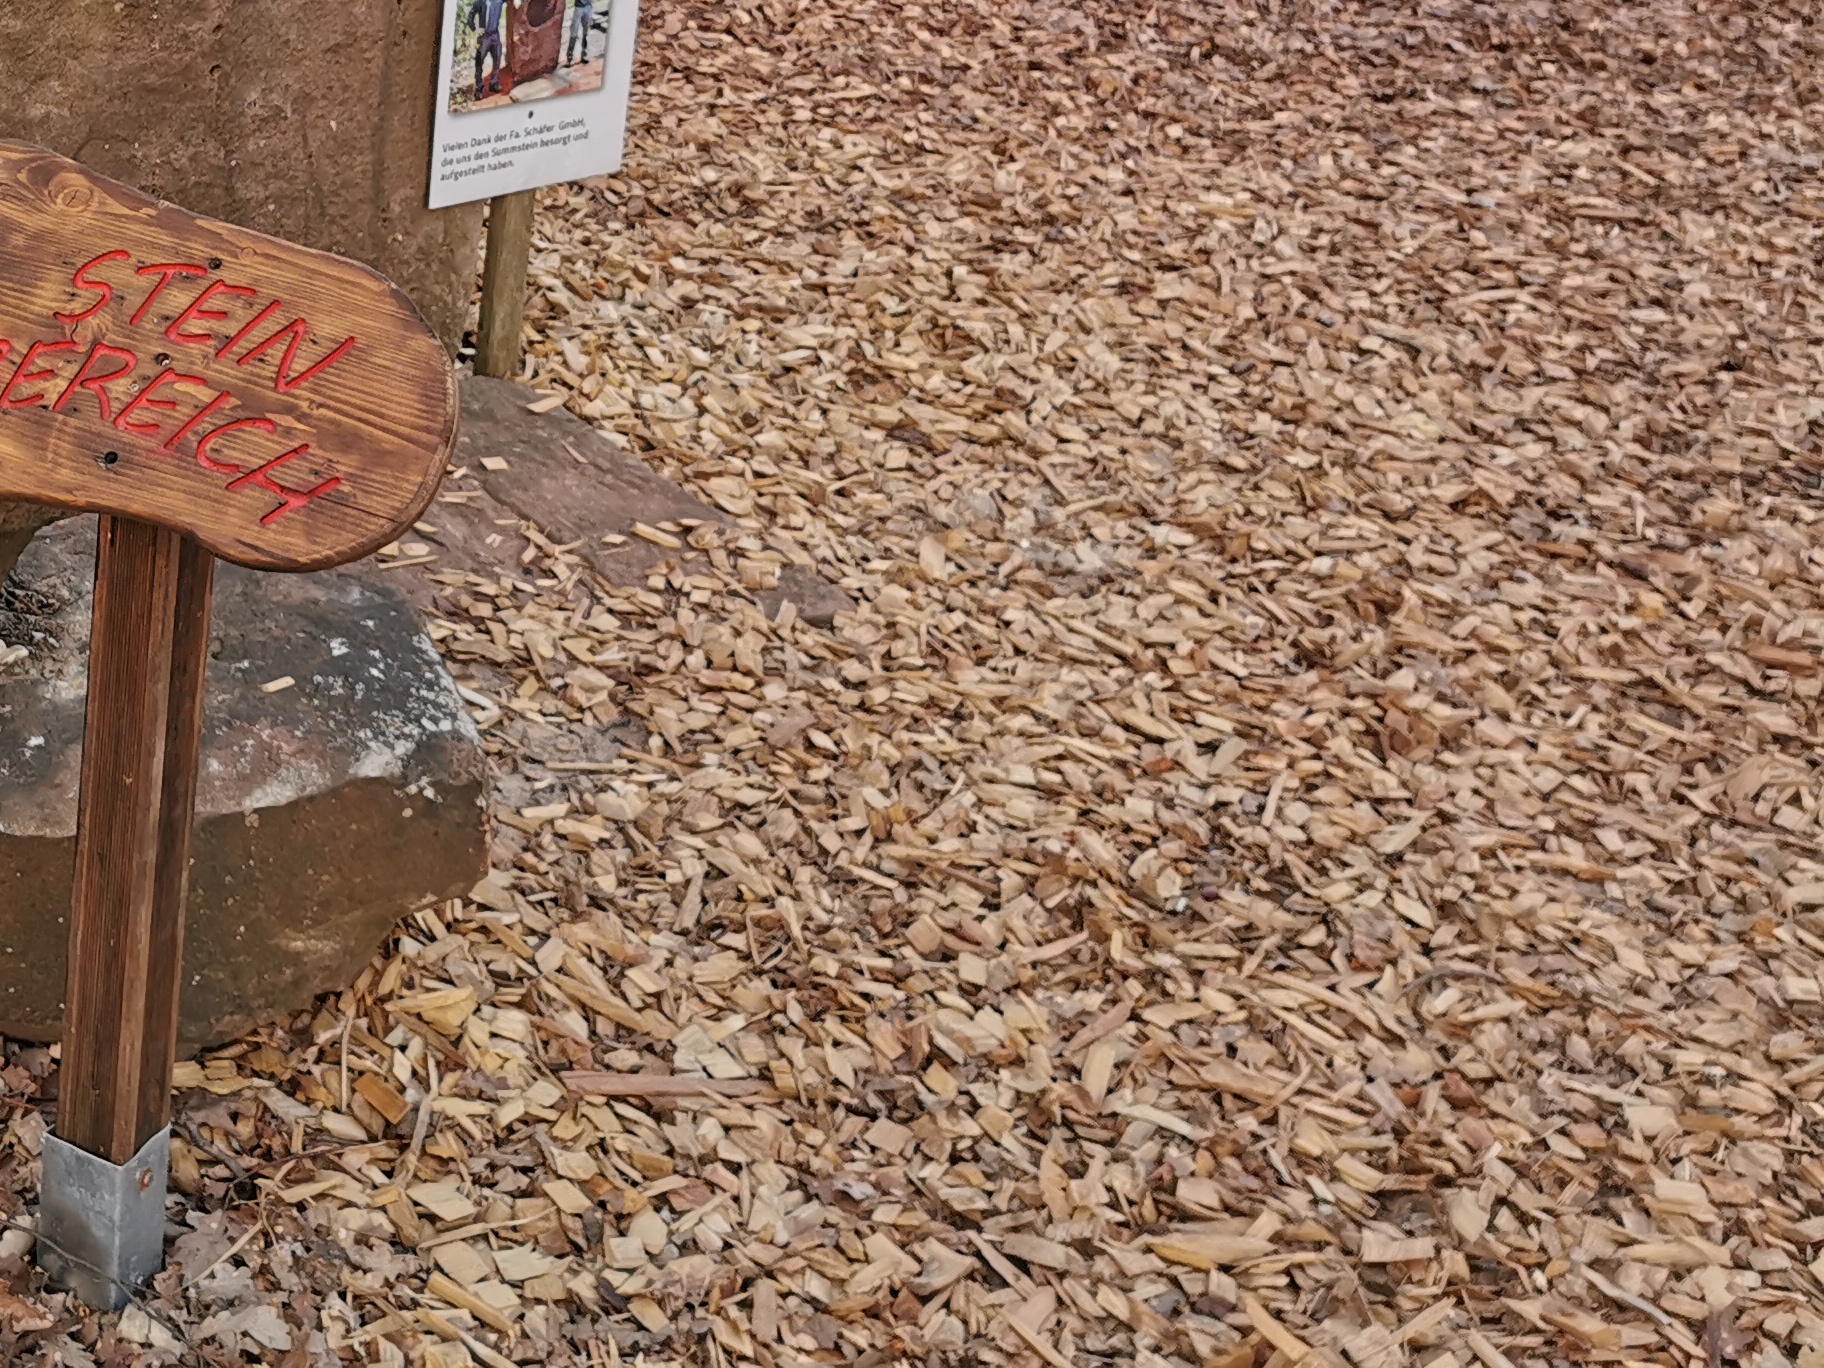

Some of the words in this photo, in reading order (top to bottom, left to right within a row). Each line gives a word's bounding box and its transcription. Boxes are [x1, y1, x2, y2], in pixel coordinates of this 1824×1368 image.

[441, 156, 454, 167] die
[456, 154, 471, 164] uns
[474, 149, 489, 161] den
[492, 140, 538, 157] Summstein
[540, 134, 572, 148] besorgt
[574, 130, 588, 141] und
[443, 140, 468, 153] Vielen
[470, 135, 491, 148] Dank
[494, 133, 507, 144] der
[509, 130, 521, 139] Fa.
[524, 124, 555, 138] Schäfer
[440, 165, 485, 181] aufgestellt
[487, 160, 514, 172] haben.
[54, 250, 355, 393] STEIN
